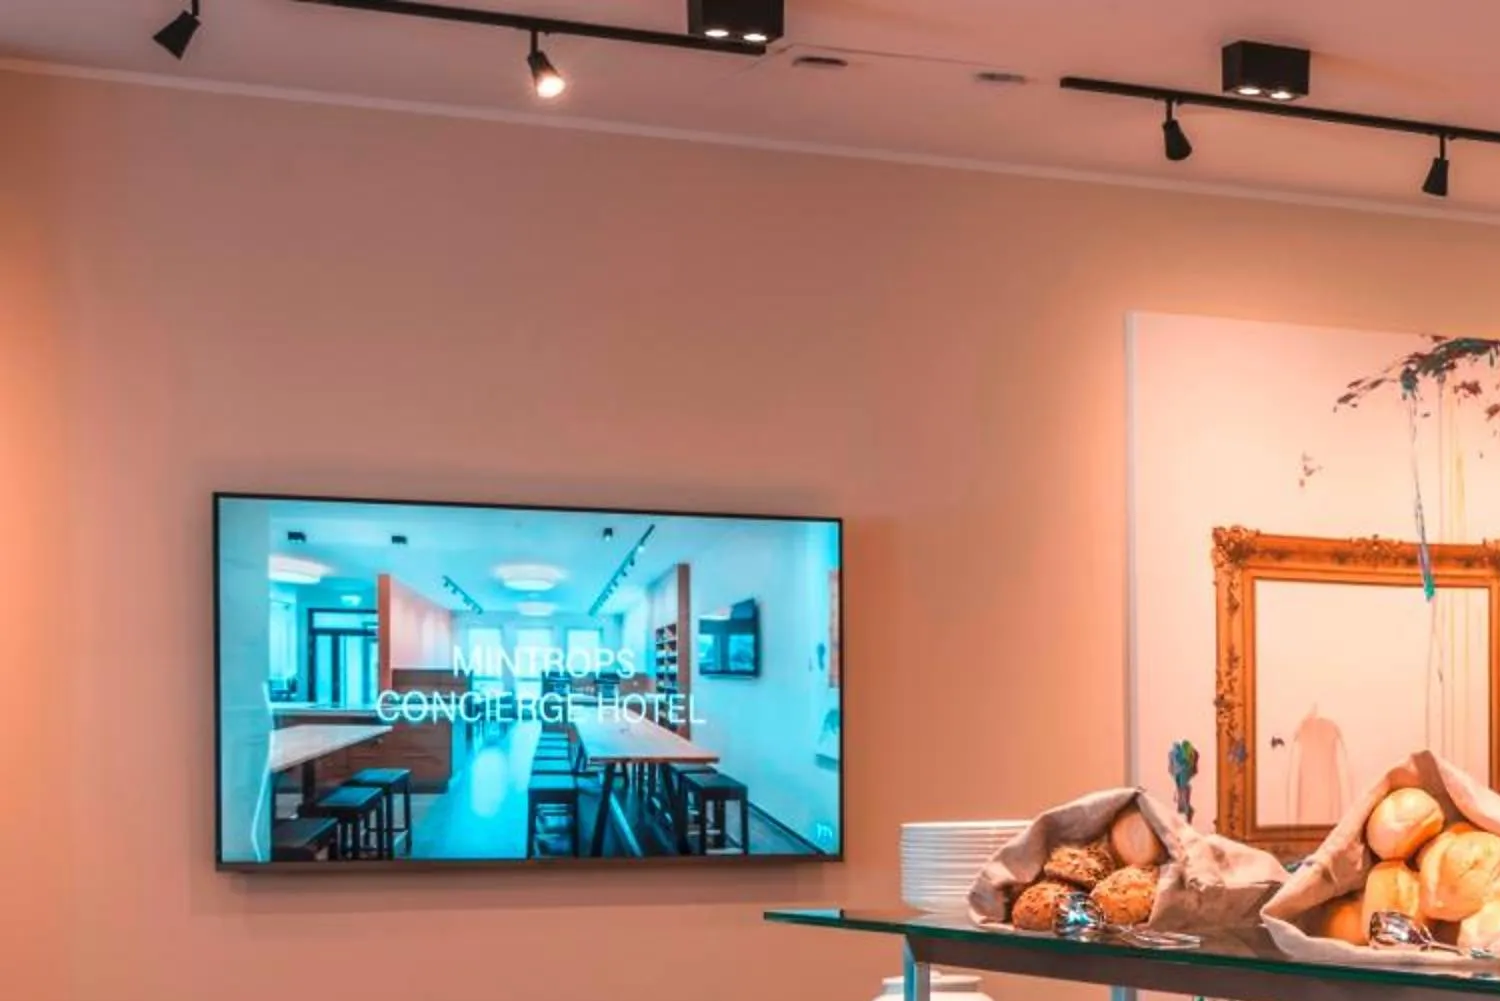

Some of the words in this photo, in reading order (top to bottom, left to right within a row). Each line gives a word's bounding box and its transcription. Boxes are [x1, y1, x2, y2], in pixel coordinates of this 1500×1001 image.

[453, 645, 635, 678] MINTROPS
[375, 690, 585, 724] CONCIERGE
[597, 692, 706, 724] HOTEL
